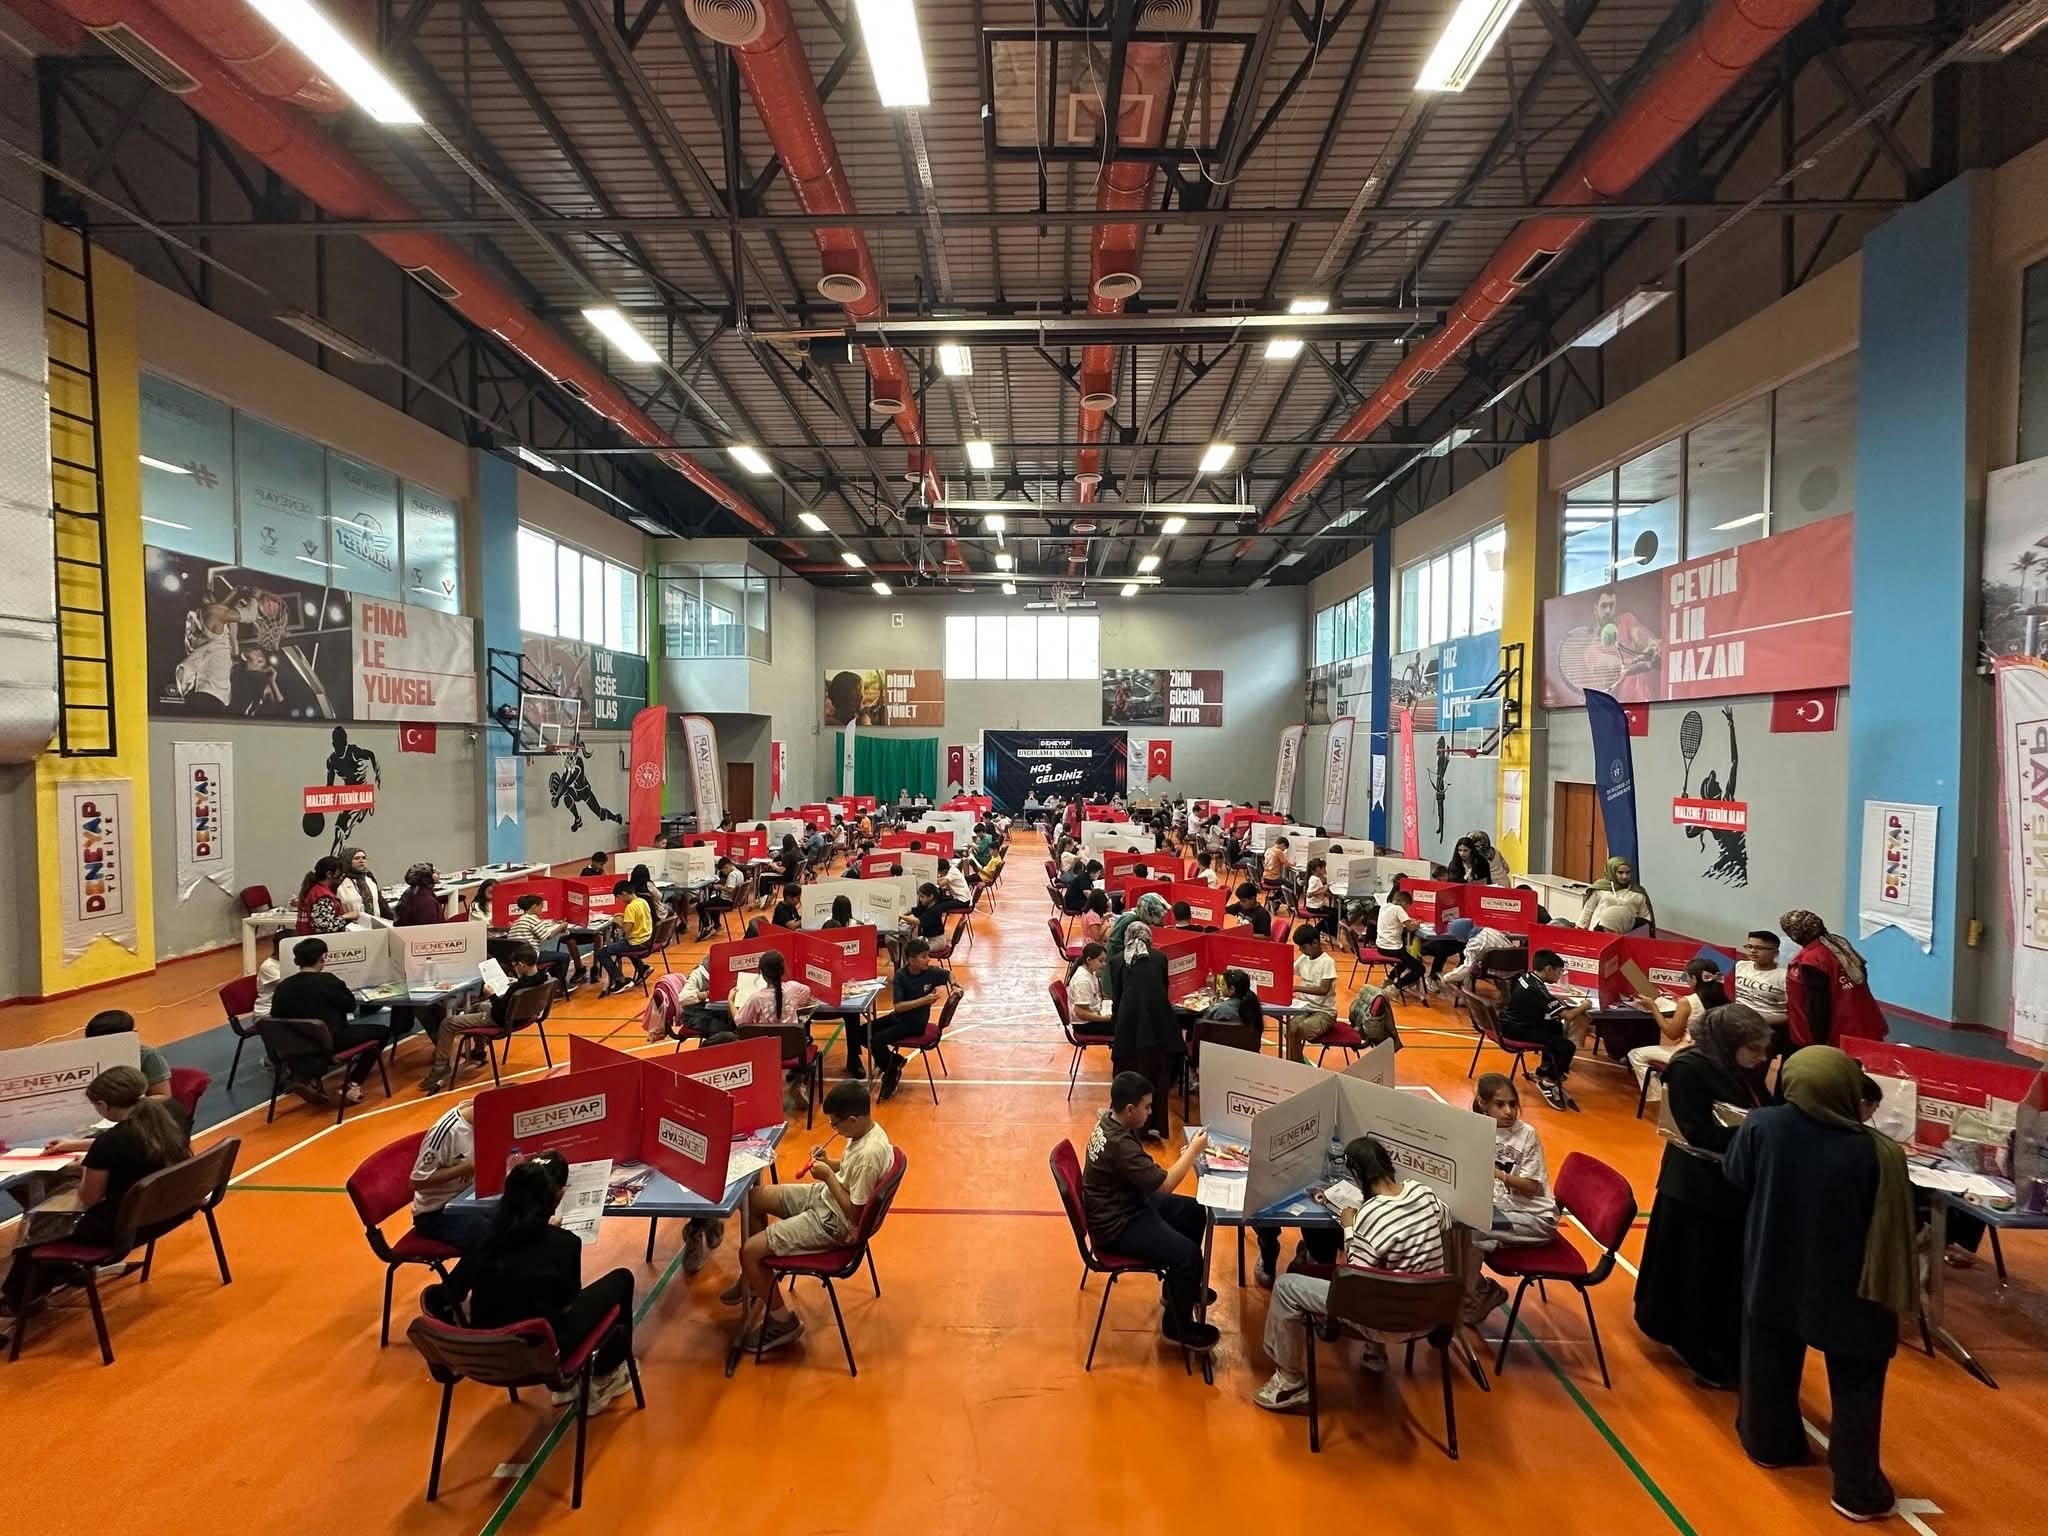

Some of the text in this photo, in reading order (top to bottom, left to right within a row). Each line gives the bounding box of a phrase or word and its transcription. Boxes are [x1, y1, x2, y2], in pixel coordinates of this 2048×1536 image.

[1670, 557, 1738, 608] ÇEVİK
[362, 603, 408, 638] FİNA
[1669, 606, 1705, 644] LİK
[362, 640, 385, 668] LE
[595, 651, 613, 674] YÜK
[1669, 641, 1745, 683] KAZAN
[362, 671, 436, 706] YÜKSEL
[1442, 674, 1454, 694] LA
[595, 699, 618, 721] ULAŞ
[1169, 707, 1200, 723] ARTTIR
[1029, 762, 1053, 774] HOŞ
[1035, 768, 1084, 785] GELDİNİZ
[194, 768, 211, 857] DENEYAP
[82, 801, 106, 913] DENEYAP
[1885, 815, 1902, 899] DENEYAP
[325, 950, 362, 960] NEYAP
[702, 1068, 748, 1085] NEYAP
[520, 1101, 600, 1128] DENEYAP
[1388, 1151, 1449, 1180] DENEY
